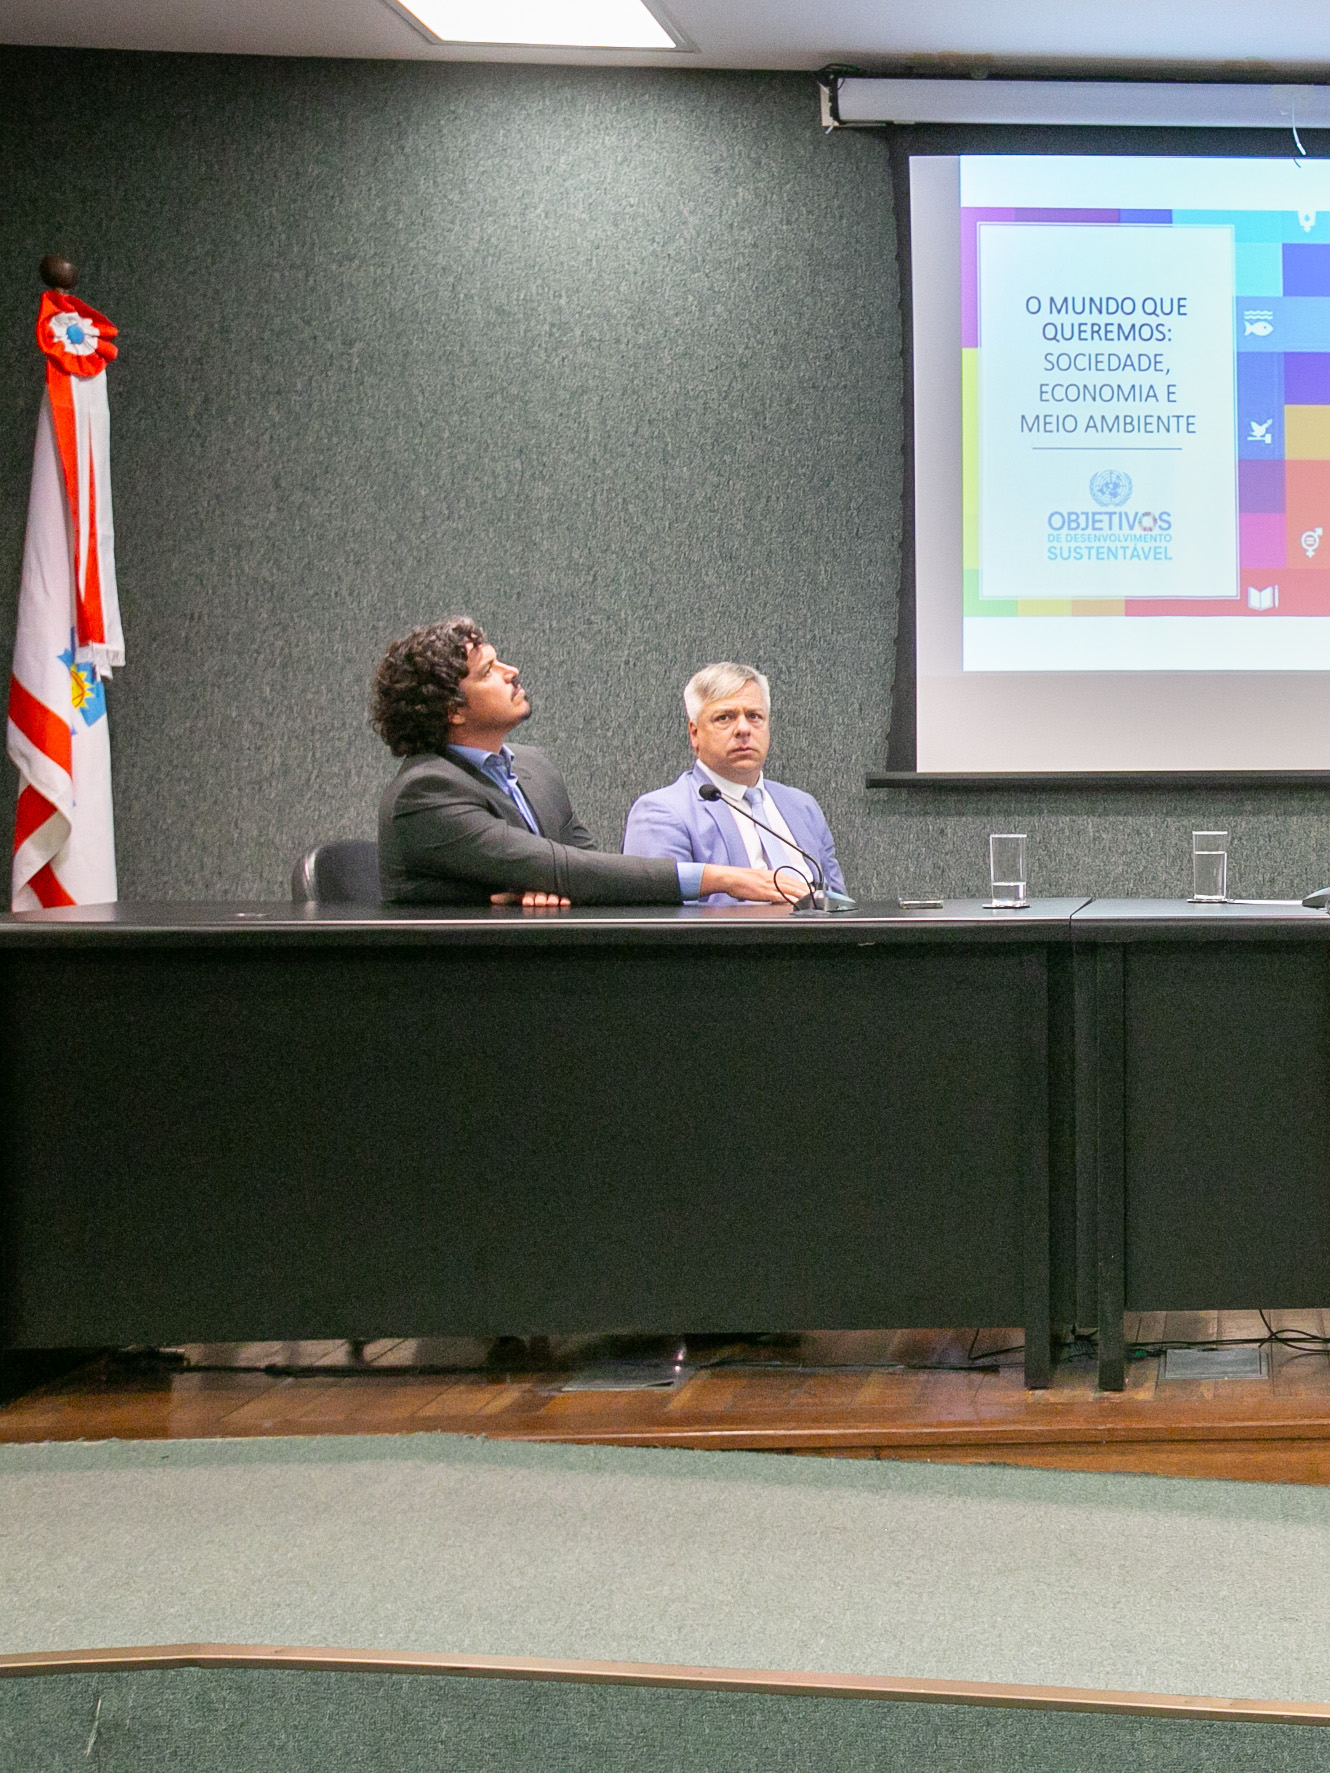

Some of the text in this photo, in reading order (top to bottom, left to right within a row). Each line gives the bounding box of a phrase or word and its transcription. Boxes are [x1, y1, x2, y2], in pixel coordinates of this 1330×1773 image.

[1025, 296, 1187, 319] O MUNDO QUE
[1042, 322, 1172, 343] QUEREMOS:
[1043, 353, 1171, 375] SOCIEDADE,
[1039, 384, 1177, 403] ECONOMIA E
[1020, 414, 1196, 434] MEIO AMBIENTE
[1047, 511, 1172, 532] OBJETIVOS
[1047, 533, 1172, 543] DE DESENVOLVIMENTO
[1047, 543, 1172, 561] SUSTENTÁVEL
